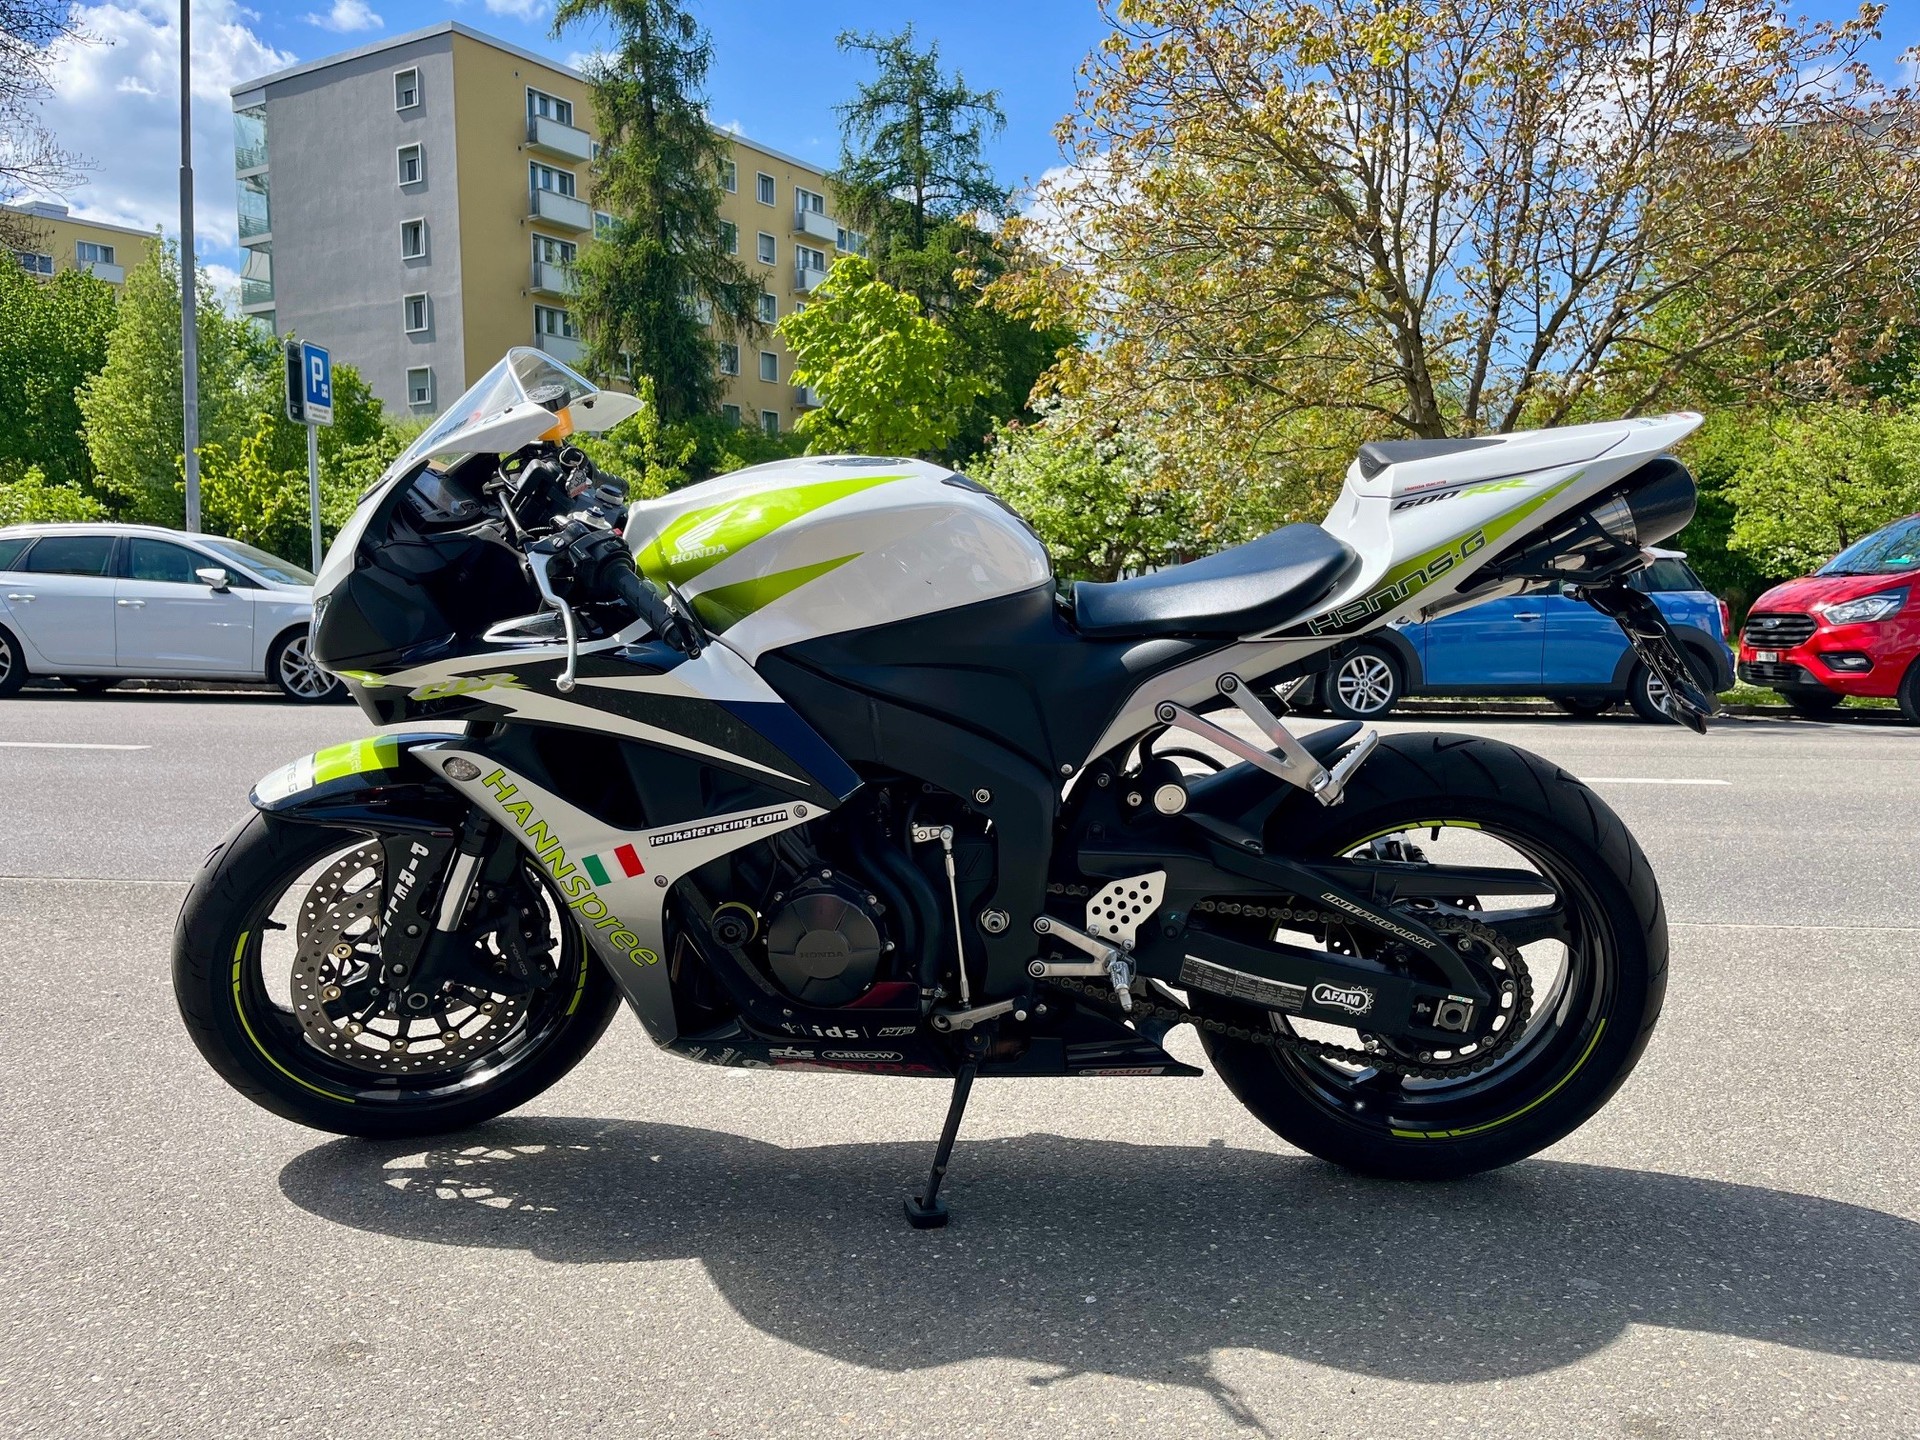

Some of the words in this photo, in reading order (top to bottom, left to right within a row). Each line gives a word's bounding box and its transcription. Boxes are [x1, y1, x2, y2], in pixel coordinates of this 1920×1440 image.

[311, 355, 324, 393] P
[670, 543, 729, 566] HONDA
[649, 810, 788, 847] tenkateracing.com
[381, 841, 430, 938] PIRELLI
[1320, 892, 1362, 915] UNIT
[510, 941, 529, 976] TOKICO
[800, 951, 845, 959] HONDA
[1320, 989, 1361, 1006] AFAM
[1098, 1068, 1153, 1076] Castrol
